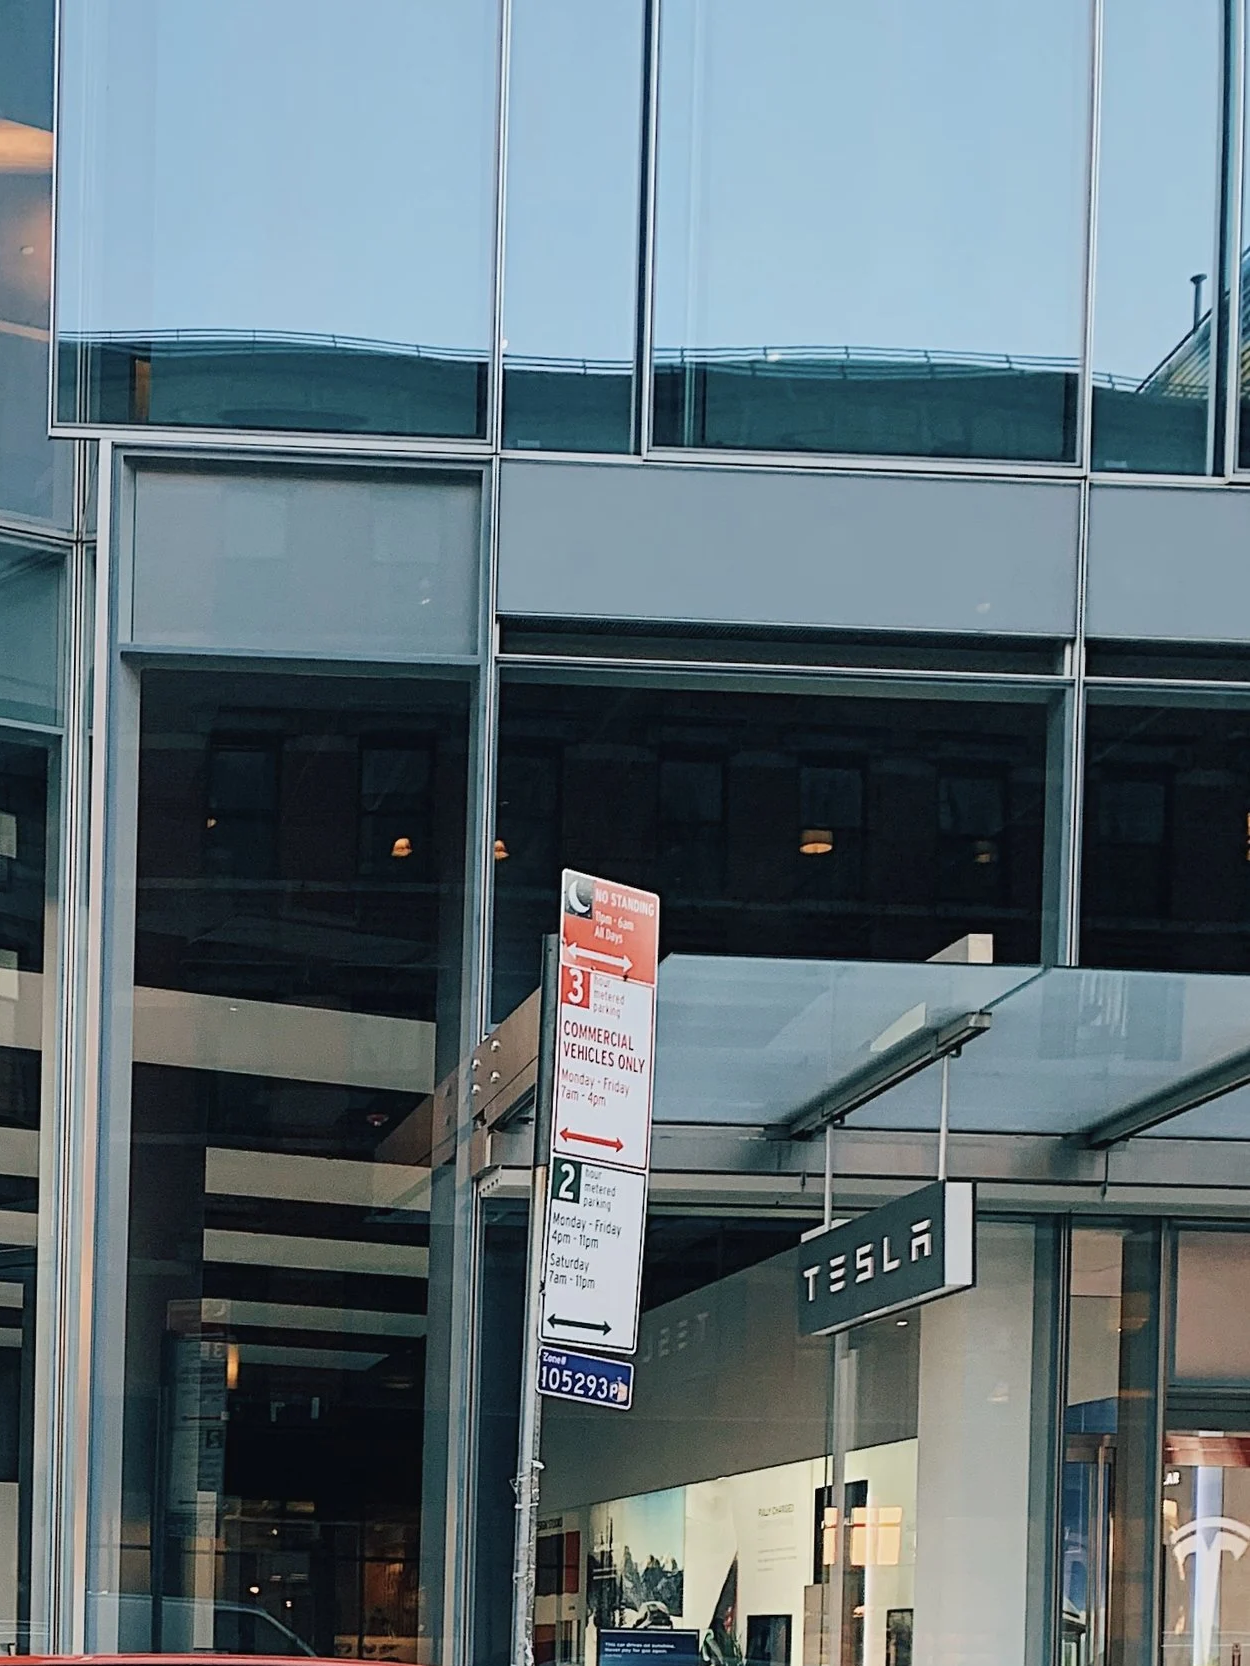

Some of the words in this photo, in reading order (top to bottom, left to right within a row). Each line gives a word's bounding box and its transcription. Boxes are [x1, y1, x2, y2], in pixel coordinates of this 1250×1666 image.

[595, 888, 609, 903] NO
[611, 893, 655, 917] STANDING
[594, 925, 605, 938] All
[605, 928, 623, 945] Days
[618, 916, 634, 931] 6am
[568, 968, 583, 1004] 3
[594, 989, 625, 1005] metered
[593, 1003, 620, 1019] parking
[563, 1020, 634, 1051] COMMERCIAL
[563, 1041, 614, 1067] VEHICLES
[618, 1054, 645, 1074] ONLY
[561, 1068, 595, 1089] Monday
[603, 1077, 630, 1098] Friday
[561, 1084, 578, 1101] 7am
[588, 1092, 606, 1107] 4pm
[558, 1163, 576, 1200] 2
[584, 1183, 616, 1198] metered
[583, 1197, 611, 1212] parking
[553, 1211, 587, 1232] Monday
[595, 1219, 622, 1239] Friday
[551, 1229, 571, 1245] 4pm
[579, 1233, 599, 1250] 11pm
[550, 1252, 590, 1274] Saturday
[802, 1218, 933, 1302] TESLA
[549, 1269, 567, 1285] 7am
[575, 1274, 596, 1290] 11pm
[542, 1366, 608, 1399] 105293
